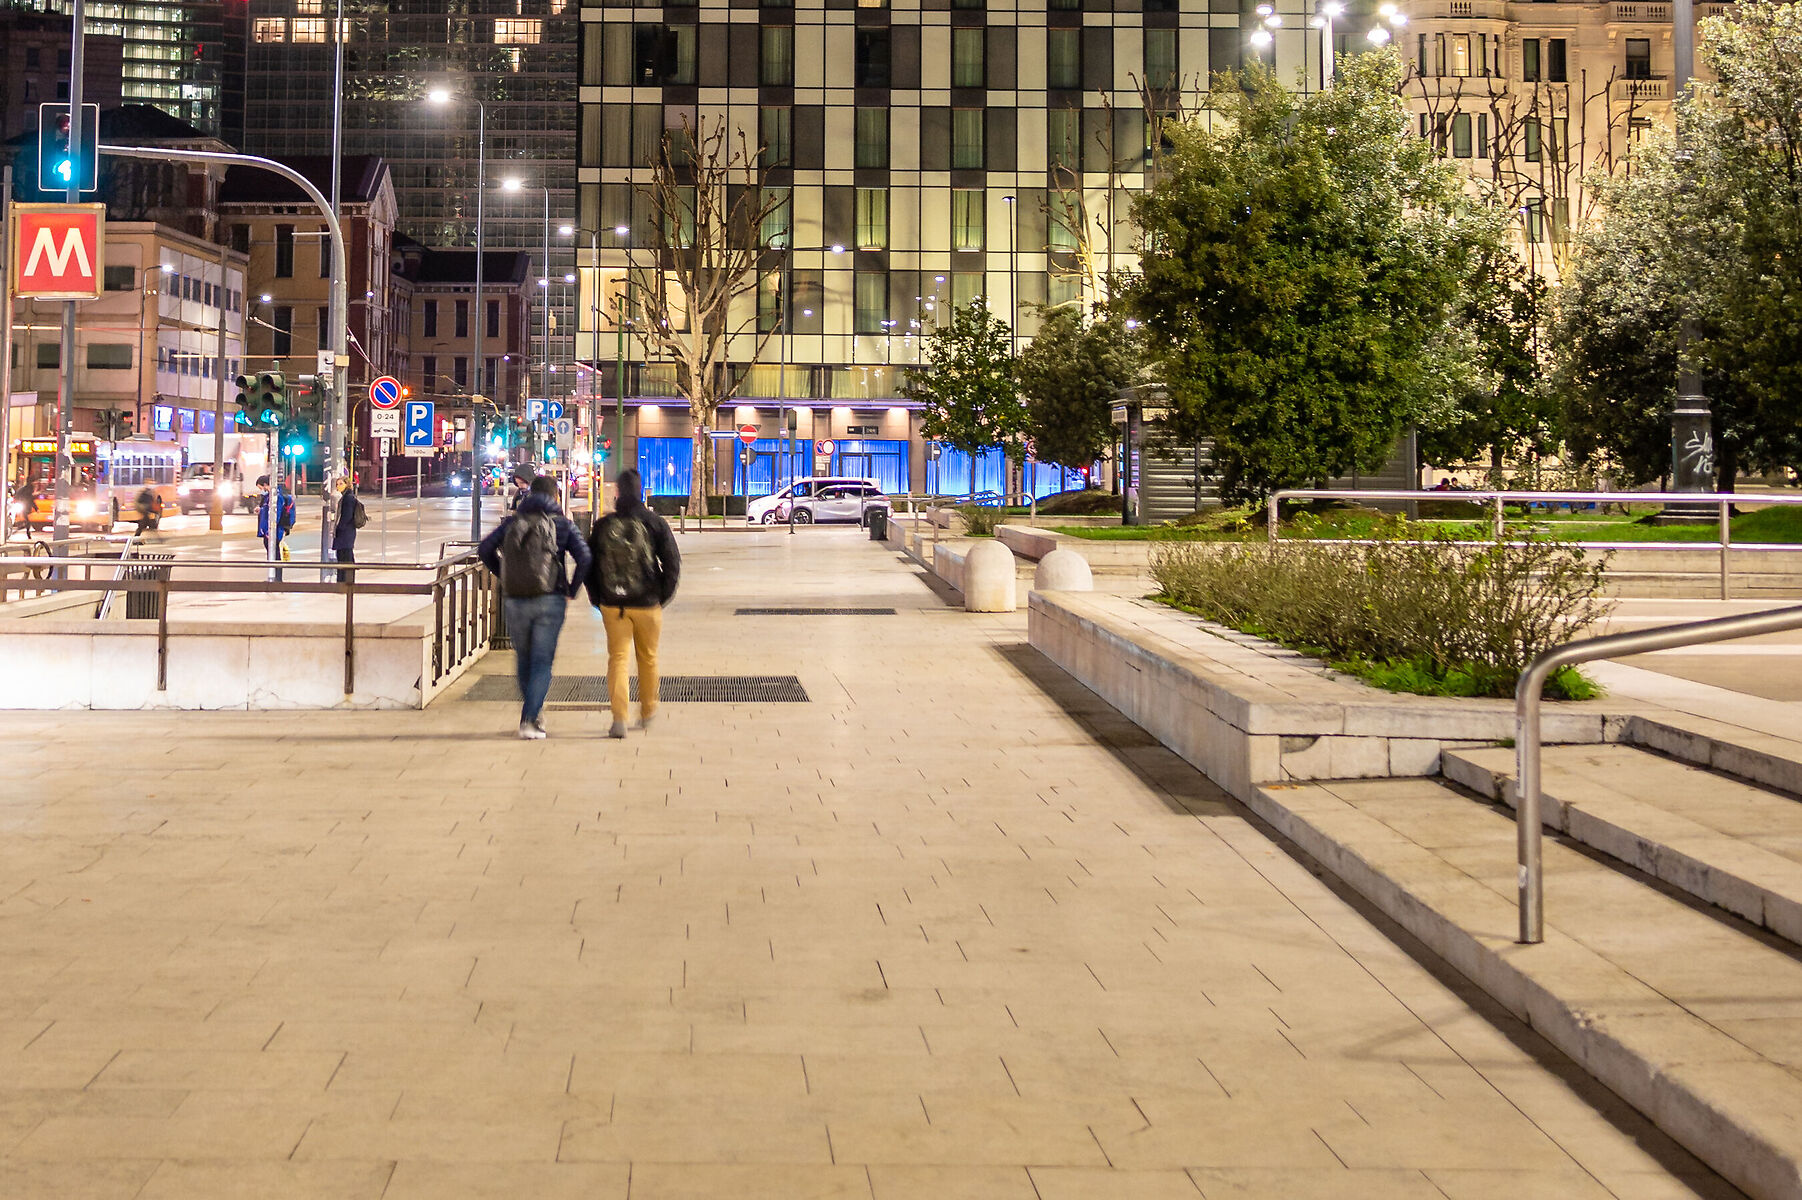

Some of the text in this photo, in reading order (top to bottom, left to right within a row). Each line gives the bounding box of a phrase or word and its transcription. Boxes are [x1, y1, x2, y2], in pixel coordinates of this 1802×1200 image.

[24, 227, 92, 277] M
[412, 404, 428, 427] P
[531, 401, 544, 418] P
